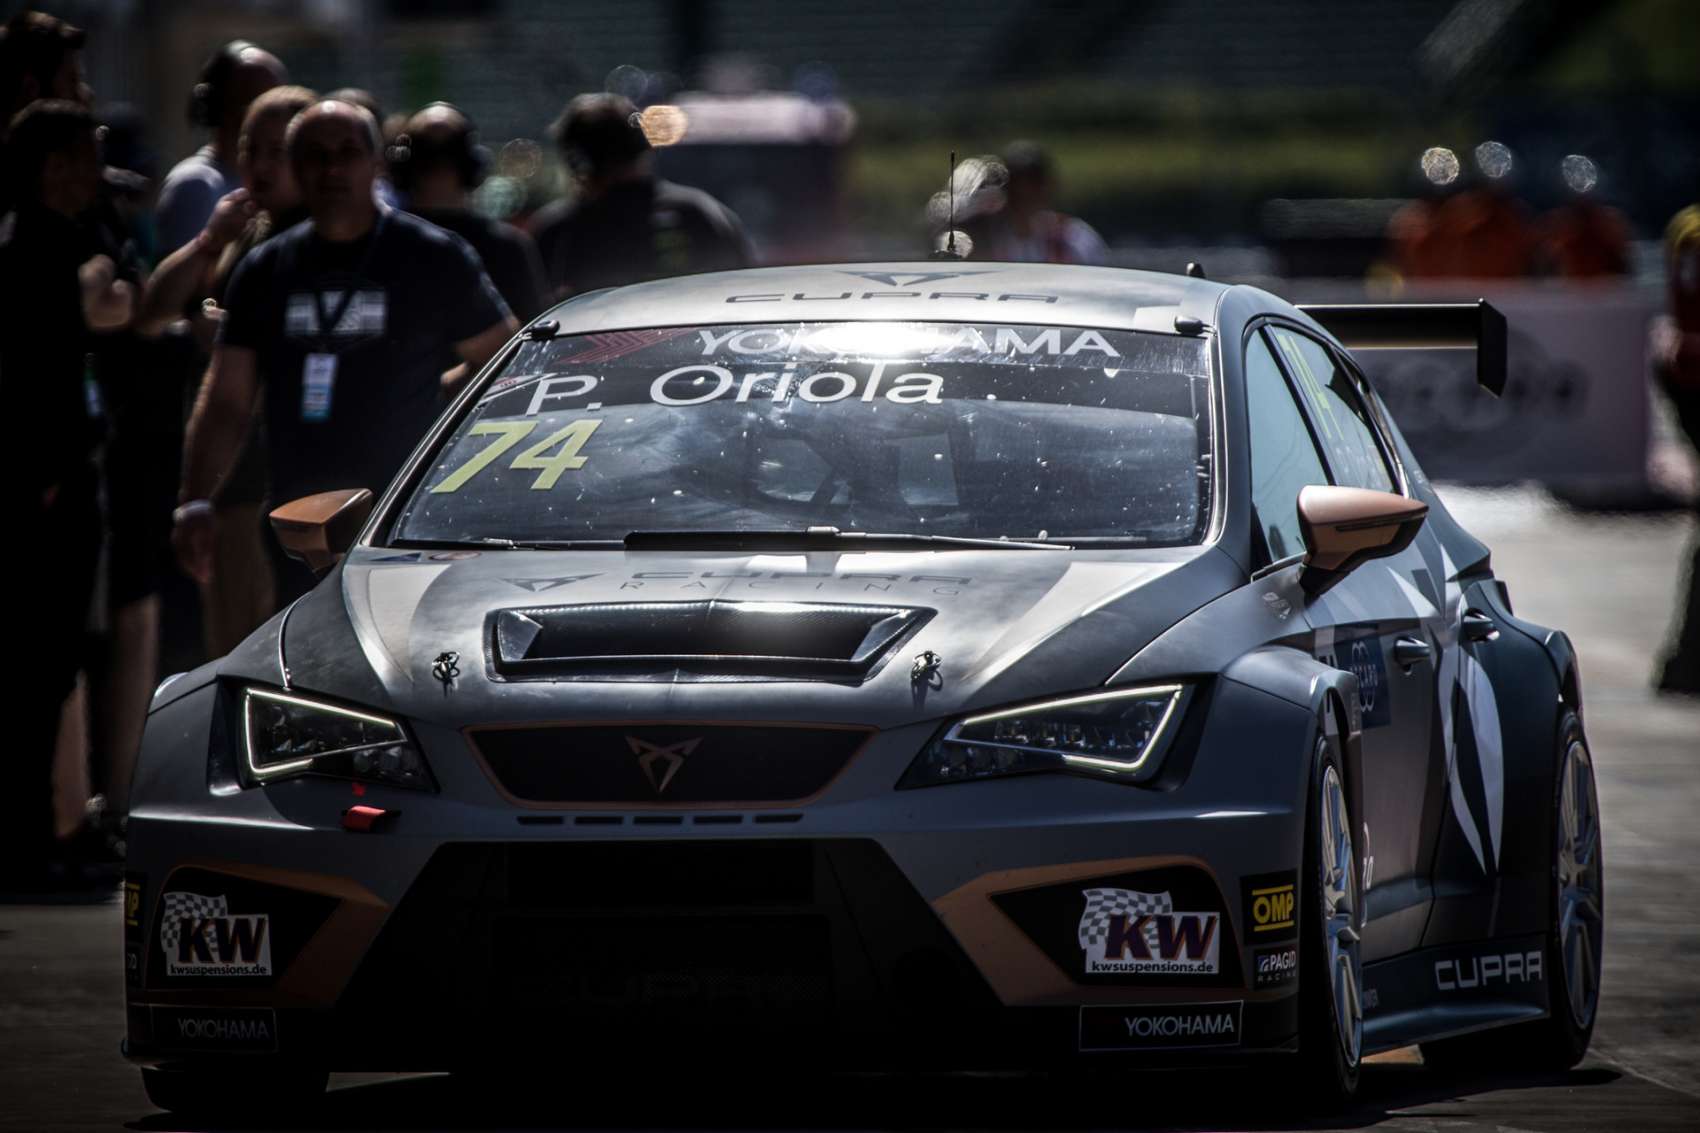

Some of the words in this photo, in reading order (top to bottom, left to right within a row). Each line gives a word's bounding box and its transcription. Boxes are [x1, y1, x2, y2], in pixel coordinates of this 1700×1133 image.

[726, 291, 1059, 304] CUPRA
[699, 327, 1121, 358] YOKAMA
[525, 374, 602, 416] P.
[650, 361, 944, 407] Oriola
[430, 419, 603, 493] 74
[620, 581, 960, 596] RACING
[1252, 893, 1294, 924] OMP
[178, 916, 266, 963] KW
[1104, 913, 1217, 961] KW
[170, 963, 267, 976] kwsuspensions.de
[1092, 960, 1213, 974] kwsuspensions.de
[1269, 950, 1297, 971] PAGID
[1434, 949, 1542, 991] CUPRA
[176, 1017, 270, 1041] YOKOHAMA
[1125, 1013, 1235, 1037] YOKOHAMA
